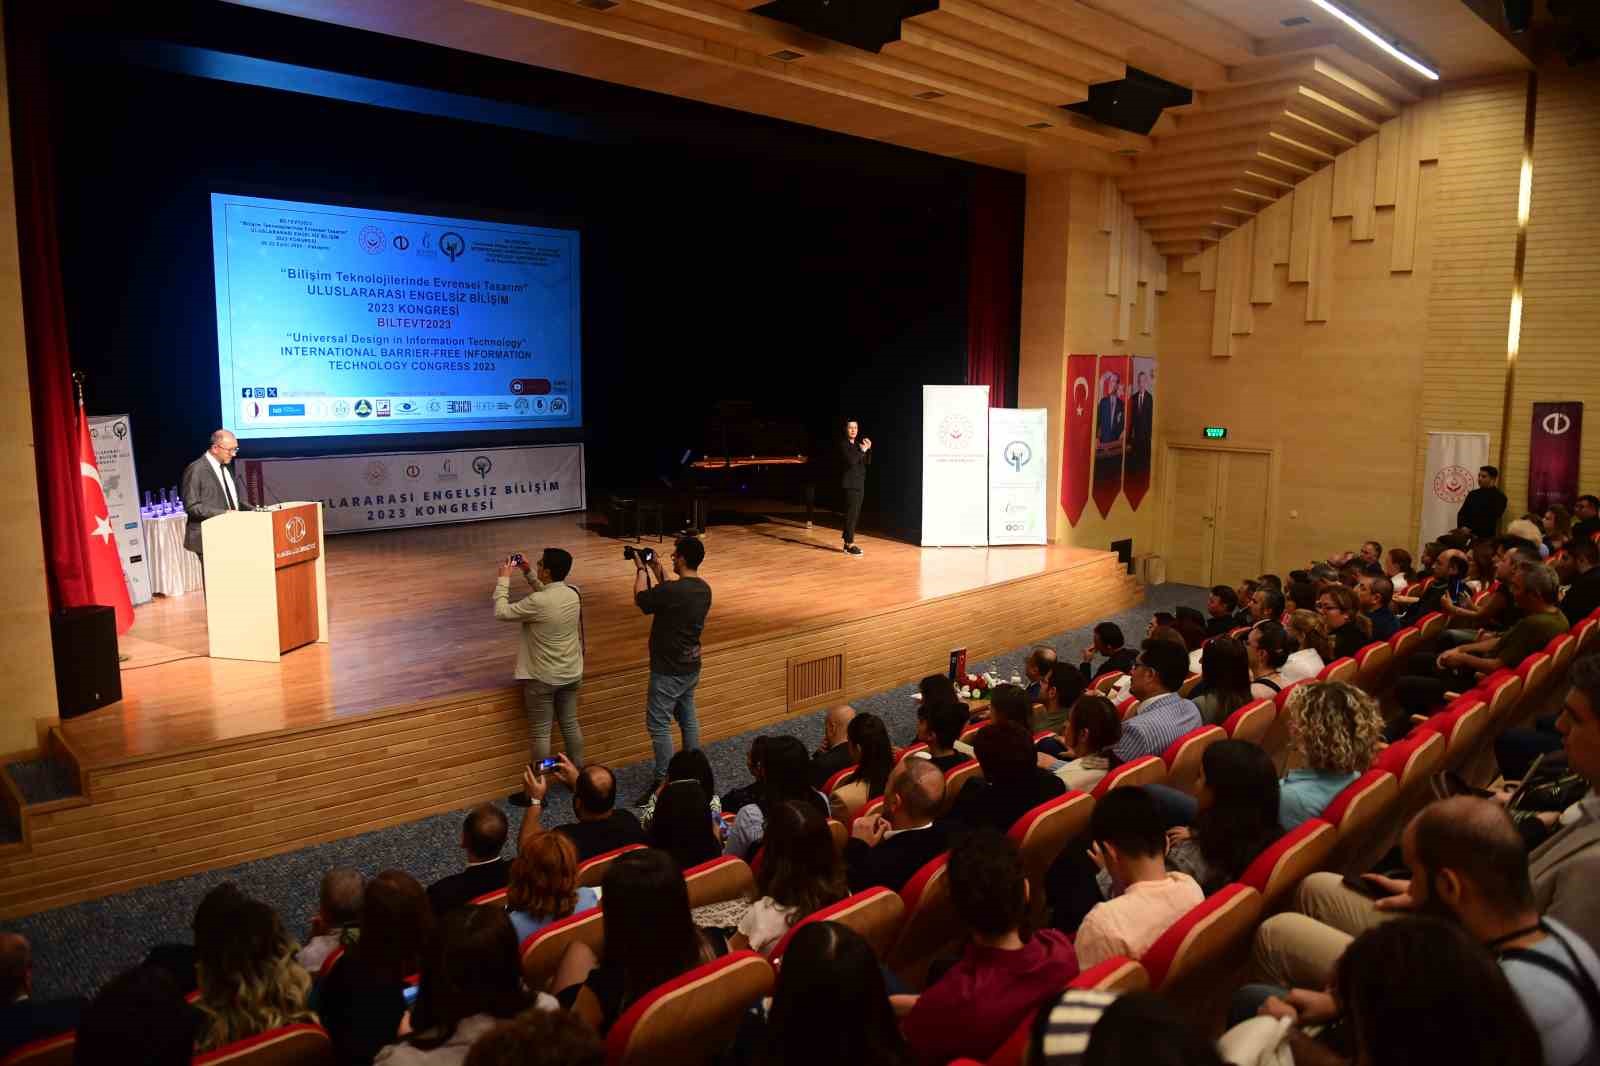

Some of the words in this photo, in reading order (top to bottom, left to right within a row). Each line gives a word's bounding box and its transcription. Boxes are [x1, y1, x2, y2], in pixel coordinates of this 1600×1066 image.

[336, 271, 430, 287] Teknolojilerinde
[307, 284, 406, 299] ULUSLARARASI
[409, 290, 466, 303] ENGELSİZ
[367, 302, 394, 313] 2023
[398, 303, 459, 316] KONGRESİ
[351, 334, 389, 346] Design
[393, 336, 403, 345] in
[406, 335, 464, 346] Information
[280, 346, 377, 357] INTERNATIONAL
[380, 347, 460, 359] BARRIER-FREE
[464, 349, 532, 360] INFORMATION
[328, 360, 408, 370] TECHNOLOGY
[411, 361, 470, 371] CONGRESS
[473, 361, 496, 371] 2023
[423, 484, 497, 501] ENGELSİZ
[504, 481, 560, 495] BİLİŞİM
[367, 508, 406, 520] 2023
[415, 498, 494, 516] KONGRESİ
